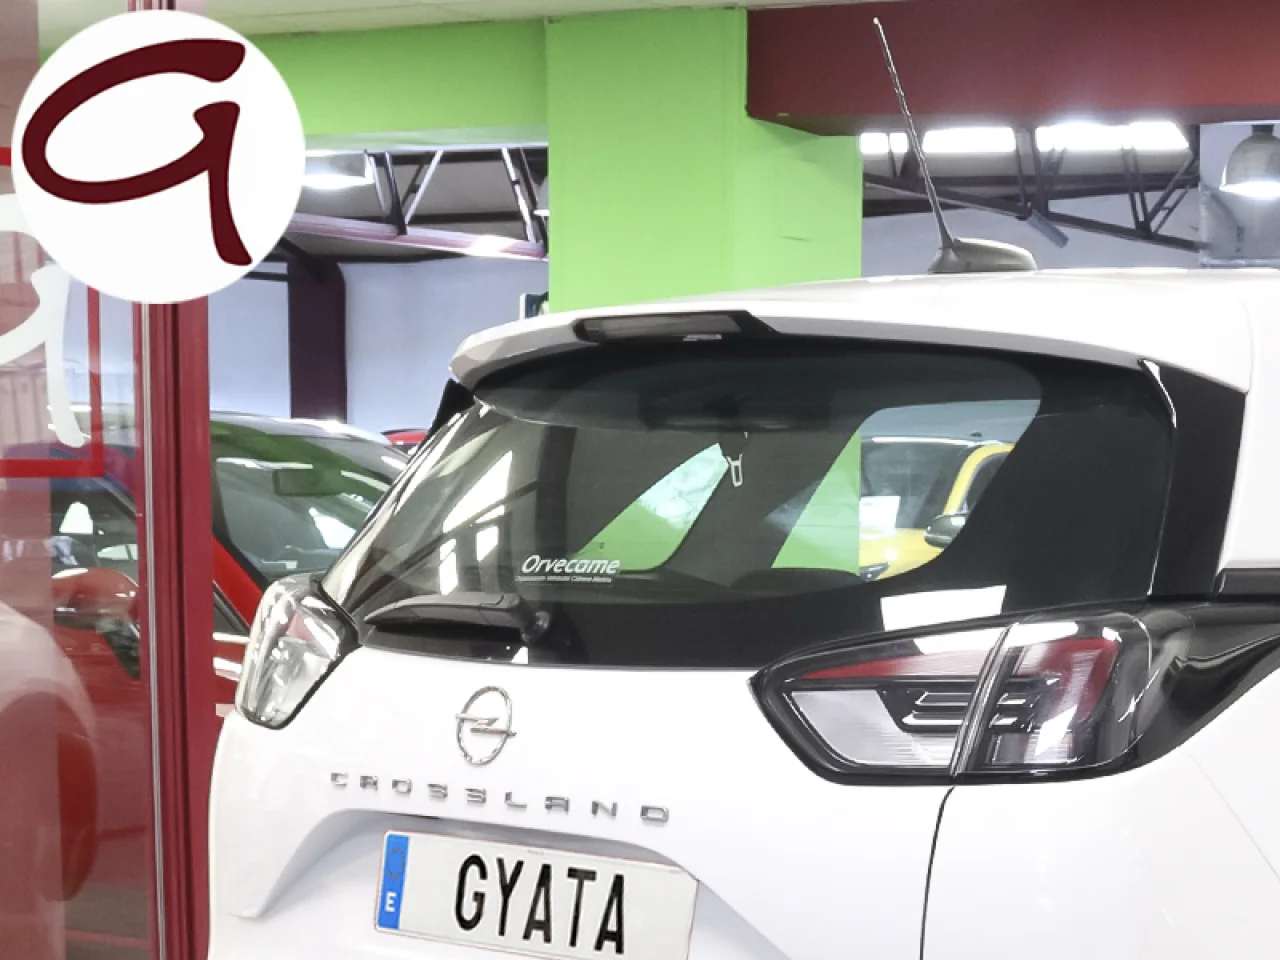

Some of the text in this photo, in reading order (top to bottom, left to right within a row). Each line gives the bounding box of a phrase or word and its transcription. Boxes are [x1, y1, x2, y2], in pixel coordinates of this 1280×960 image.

[520, 554, 622, 574] Orvecame
[330, 772, 670, 824] CROSSLAND
[384, 853, 625, 955] E GYATA
